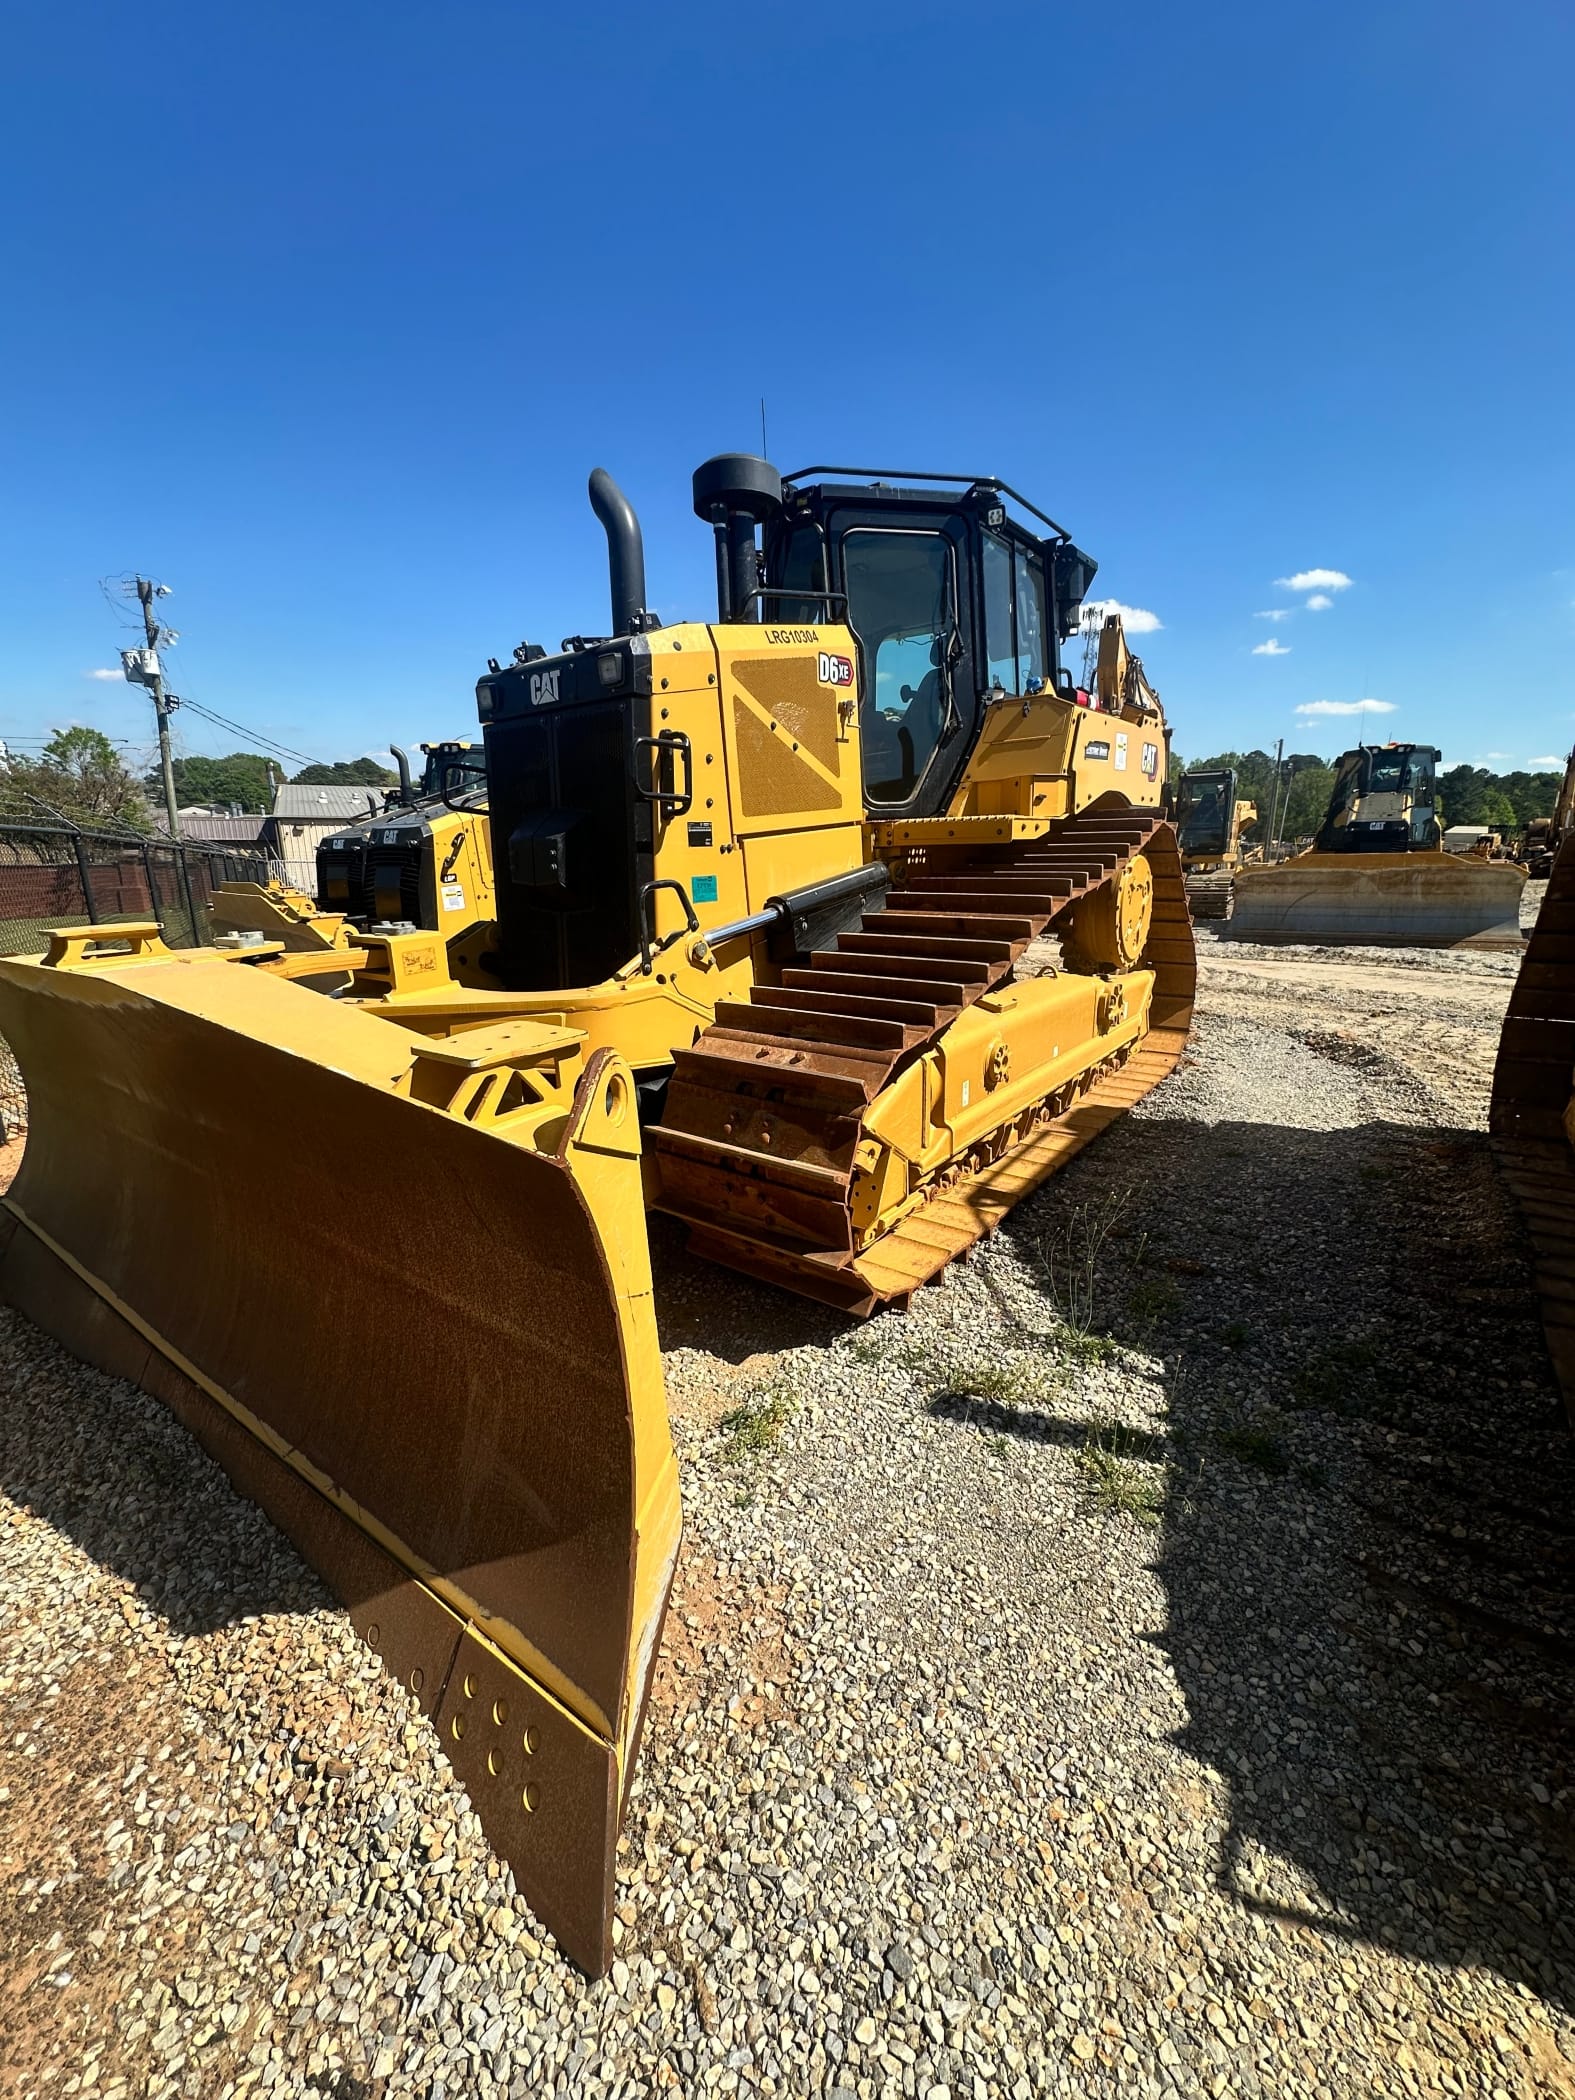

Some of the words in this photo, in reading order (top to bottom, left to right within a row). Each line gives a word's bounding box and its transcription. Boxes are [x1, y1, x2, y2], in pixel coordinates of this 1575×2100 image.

[764, 630, 819, 644] LRG10304
[530, 670, 560, 705] CAT
[1141, 742, 1157, 774] CAT
[1370, 822, 1386, 831] CAT
[383, 830, 399, 844] CAT
[333, 840, 345, 849] CAT
